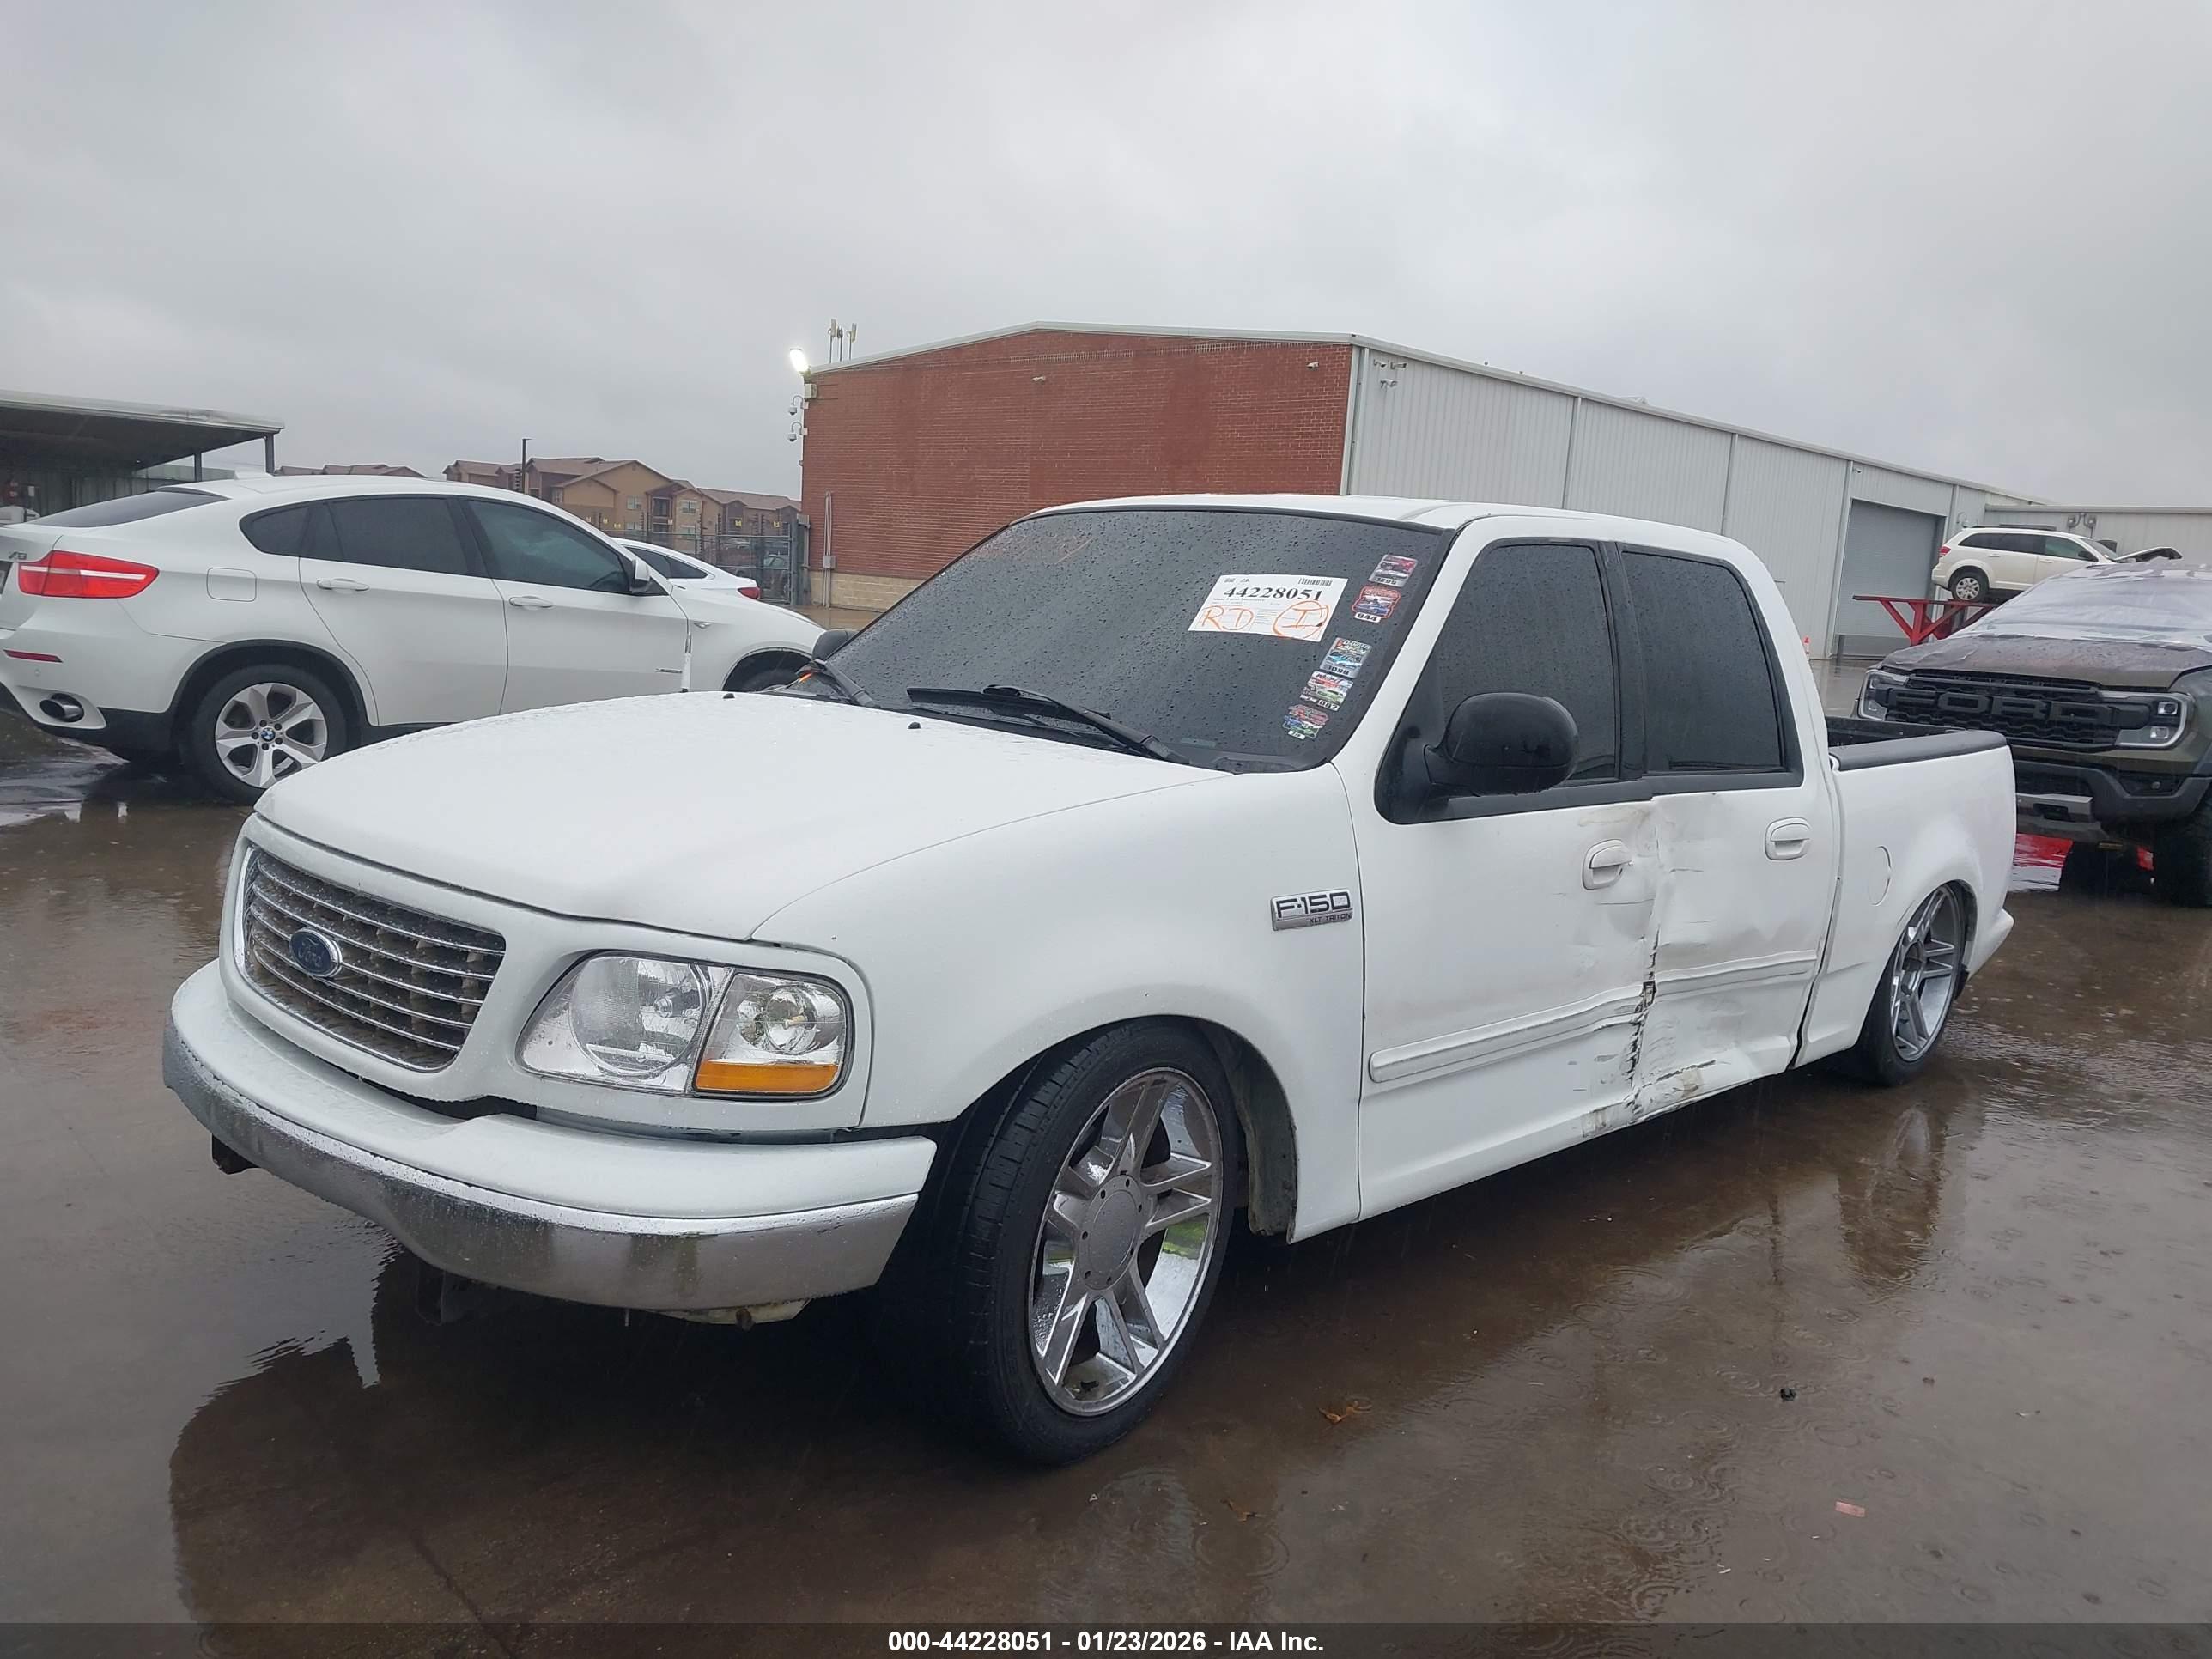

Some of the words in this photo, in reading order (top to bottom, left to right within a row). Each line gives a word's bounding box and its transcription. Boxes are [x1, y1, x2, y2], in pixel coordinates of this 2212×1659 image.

[1224, 586, 1322, 601] 44228051
[1276, 891, 1352, 918] F-150
[1310, 916, 1322, 925] XLT
[1325, 912, 1353, 922] TRITON
